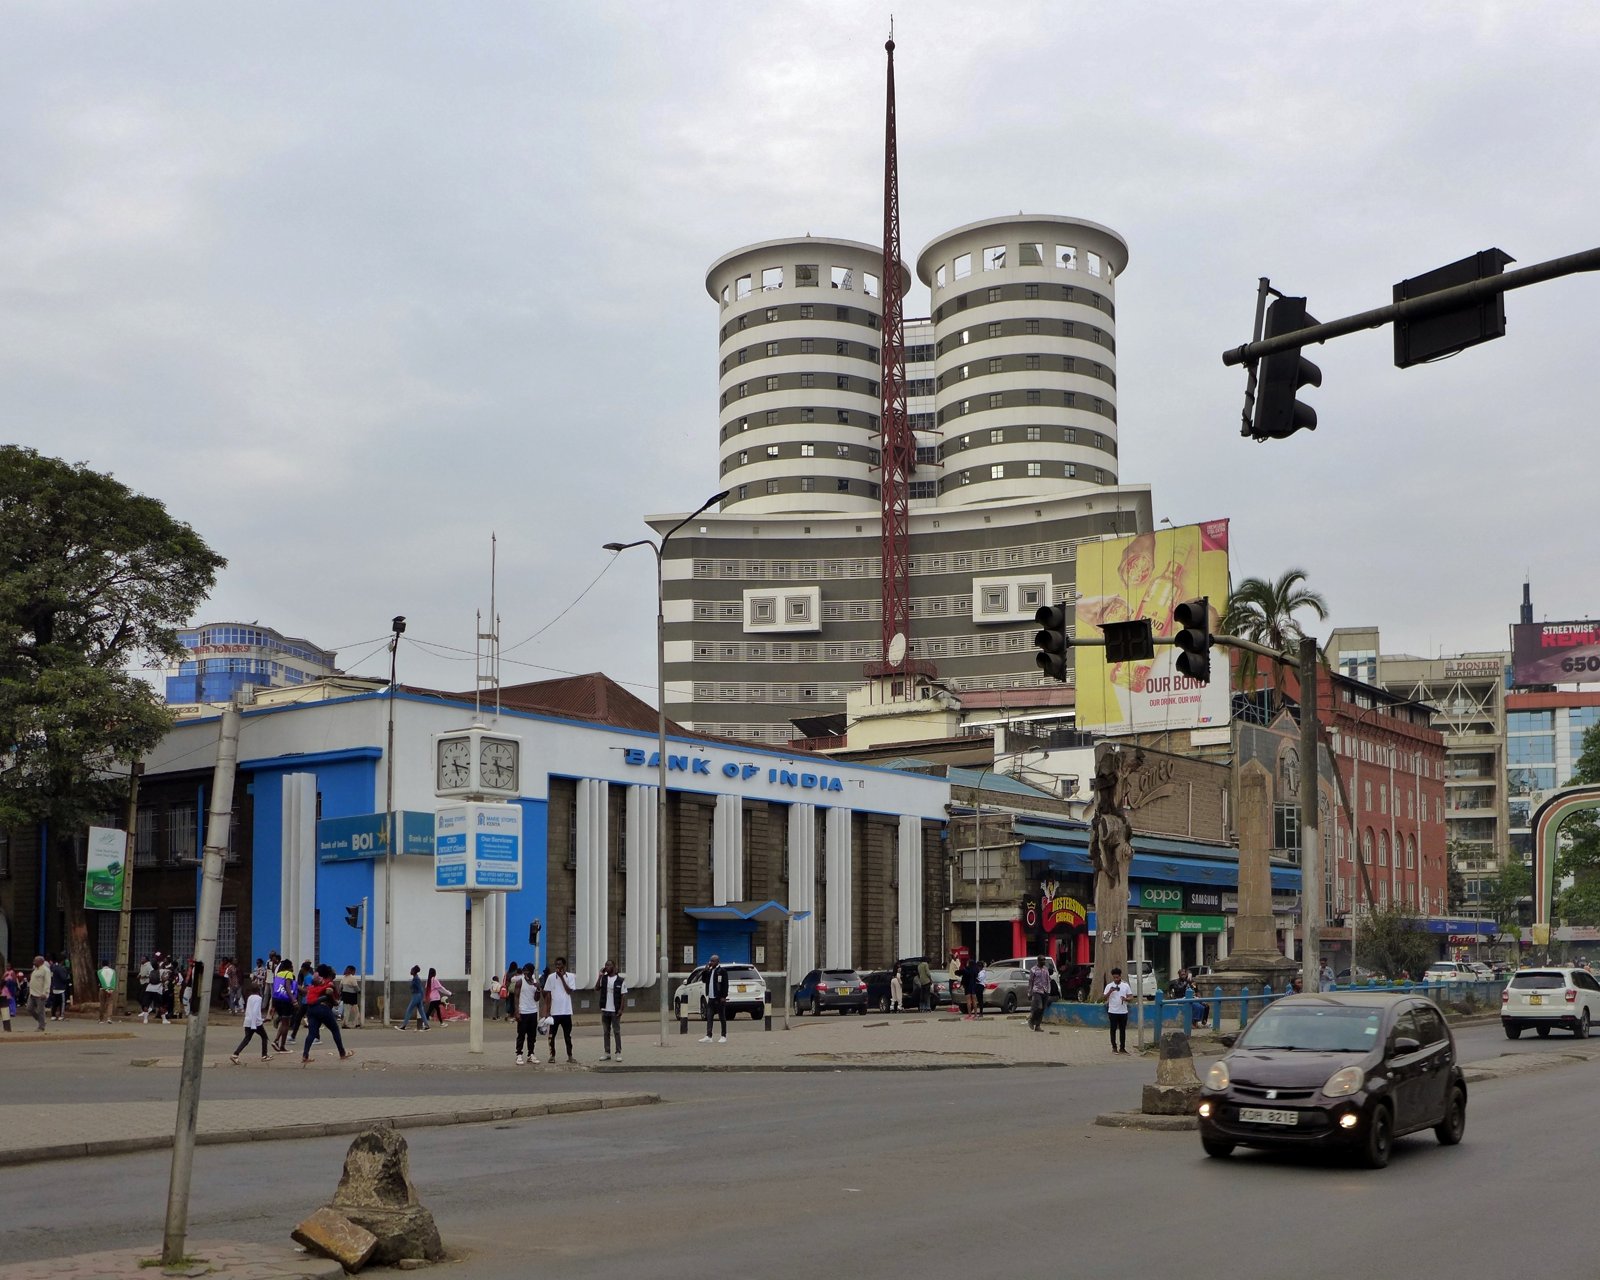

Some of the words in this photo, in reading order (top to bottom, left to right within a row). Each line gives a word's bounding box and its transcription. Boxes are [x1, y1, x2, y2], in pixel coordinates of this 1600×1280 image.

[1457, 661, 1500, 670] PIONEER
[1145, 677, 1171, 693] OUR
[1149, 699, 1161, 707] OUR
[1178, 696, 1190, 704] OUR
[625, 748, 712, 775] BANK
[722, 762, 760, 780] OF
[768, 768, 843, 792] INDIA
[352, 832, 374, 850] BOI
[1144, 889, 1180, 903] oppo
[1191, 893, 1219, 906] SAMSUNG
[1179, 920, 1202, 929] Safaricom
[1450, 935, 1476, 945] Bata
